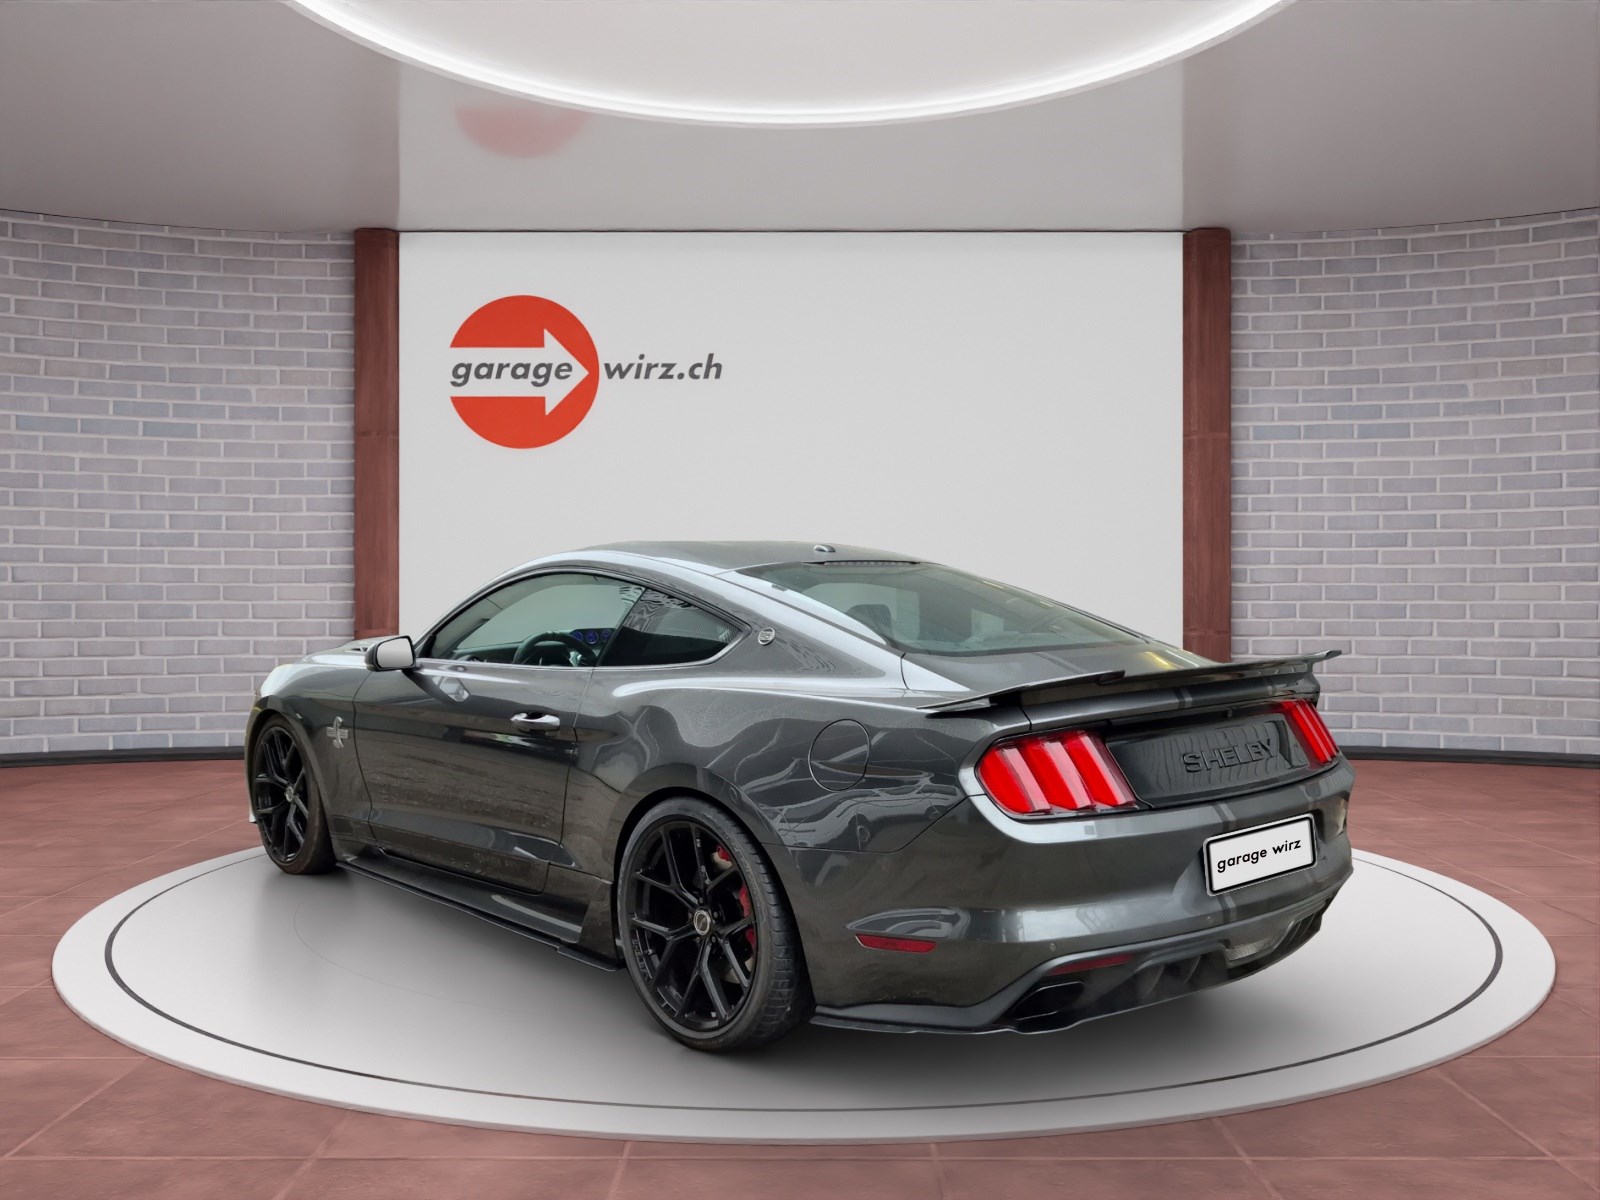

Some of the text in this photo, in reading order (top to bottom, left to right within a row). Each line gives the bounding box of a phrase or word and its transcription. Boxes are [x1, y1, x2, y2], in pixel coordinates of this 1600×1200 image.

[450, 353, 723, 387] garage wirz.ch
[1182, 738, 1274, 773] SHELBY
[1217, 838, 1302, 873] garage wirz
